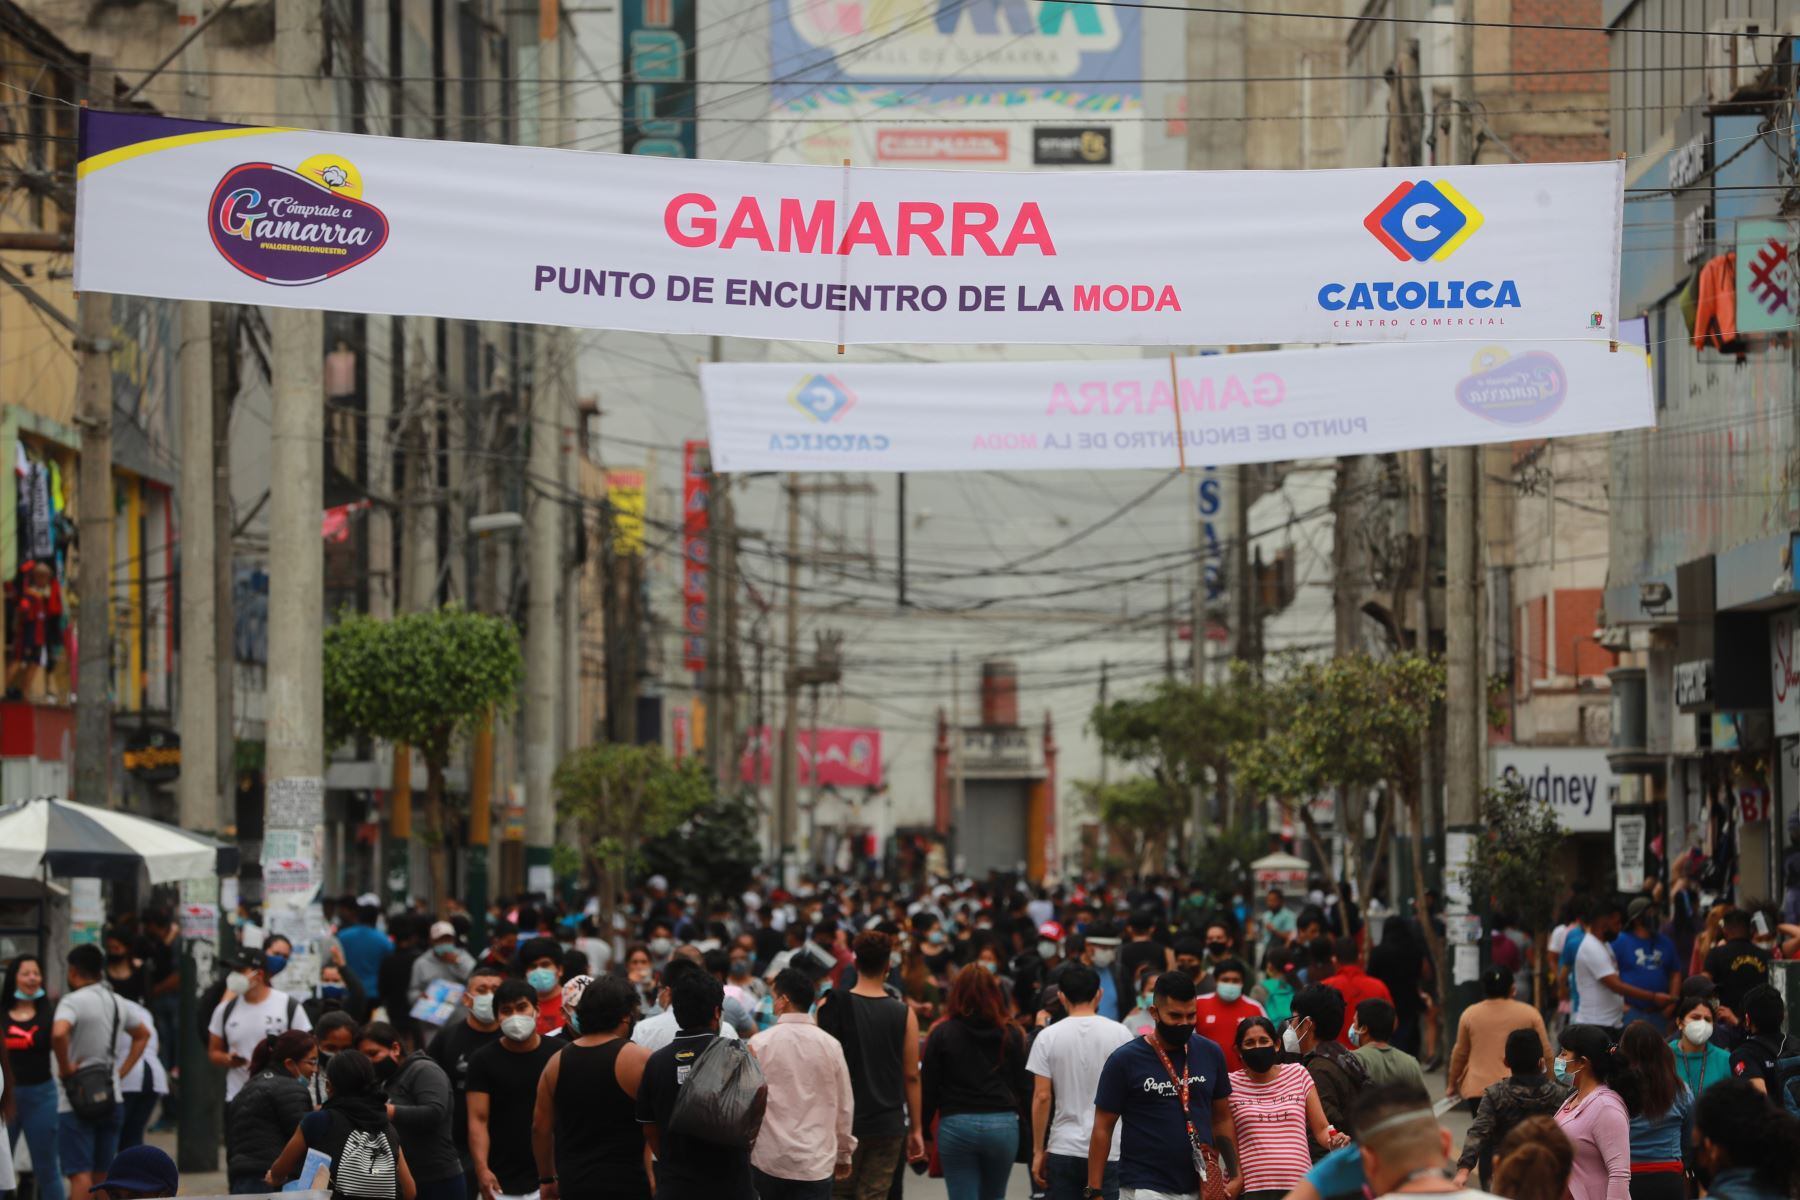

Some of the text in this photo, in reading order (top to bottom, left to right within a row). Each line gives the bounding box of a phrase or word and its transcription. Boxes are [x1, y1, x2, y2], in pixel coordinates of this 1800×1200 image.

[220, 187, 374, 246] Gamarra
[268, 196, 340, 218] Cómprale
[664, 192, 1057, 257] GAMARRA
[259, 241, 348, 256] #VALOREMOSLONUESTRO
[535, 266, 1182, 313] PUNTO DE ENCUENTRO DE LA MODA
[1317, 280, 1521, 311] CATOLICA
[1333, 316, 1505, 328] CENTRO COMERCIAL
[1503, 765, 1597, 816] Sydney
[1143, 1077, 1173, 1095] Pepe
